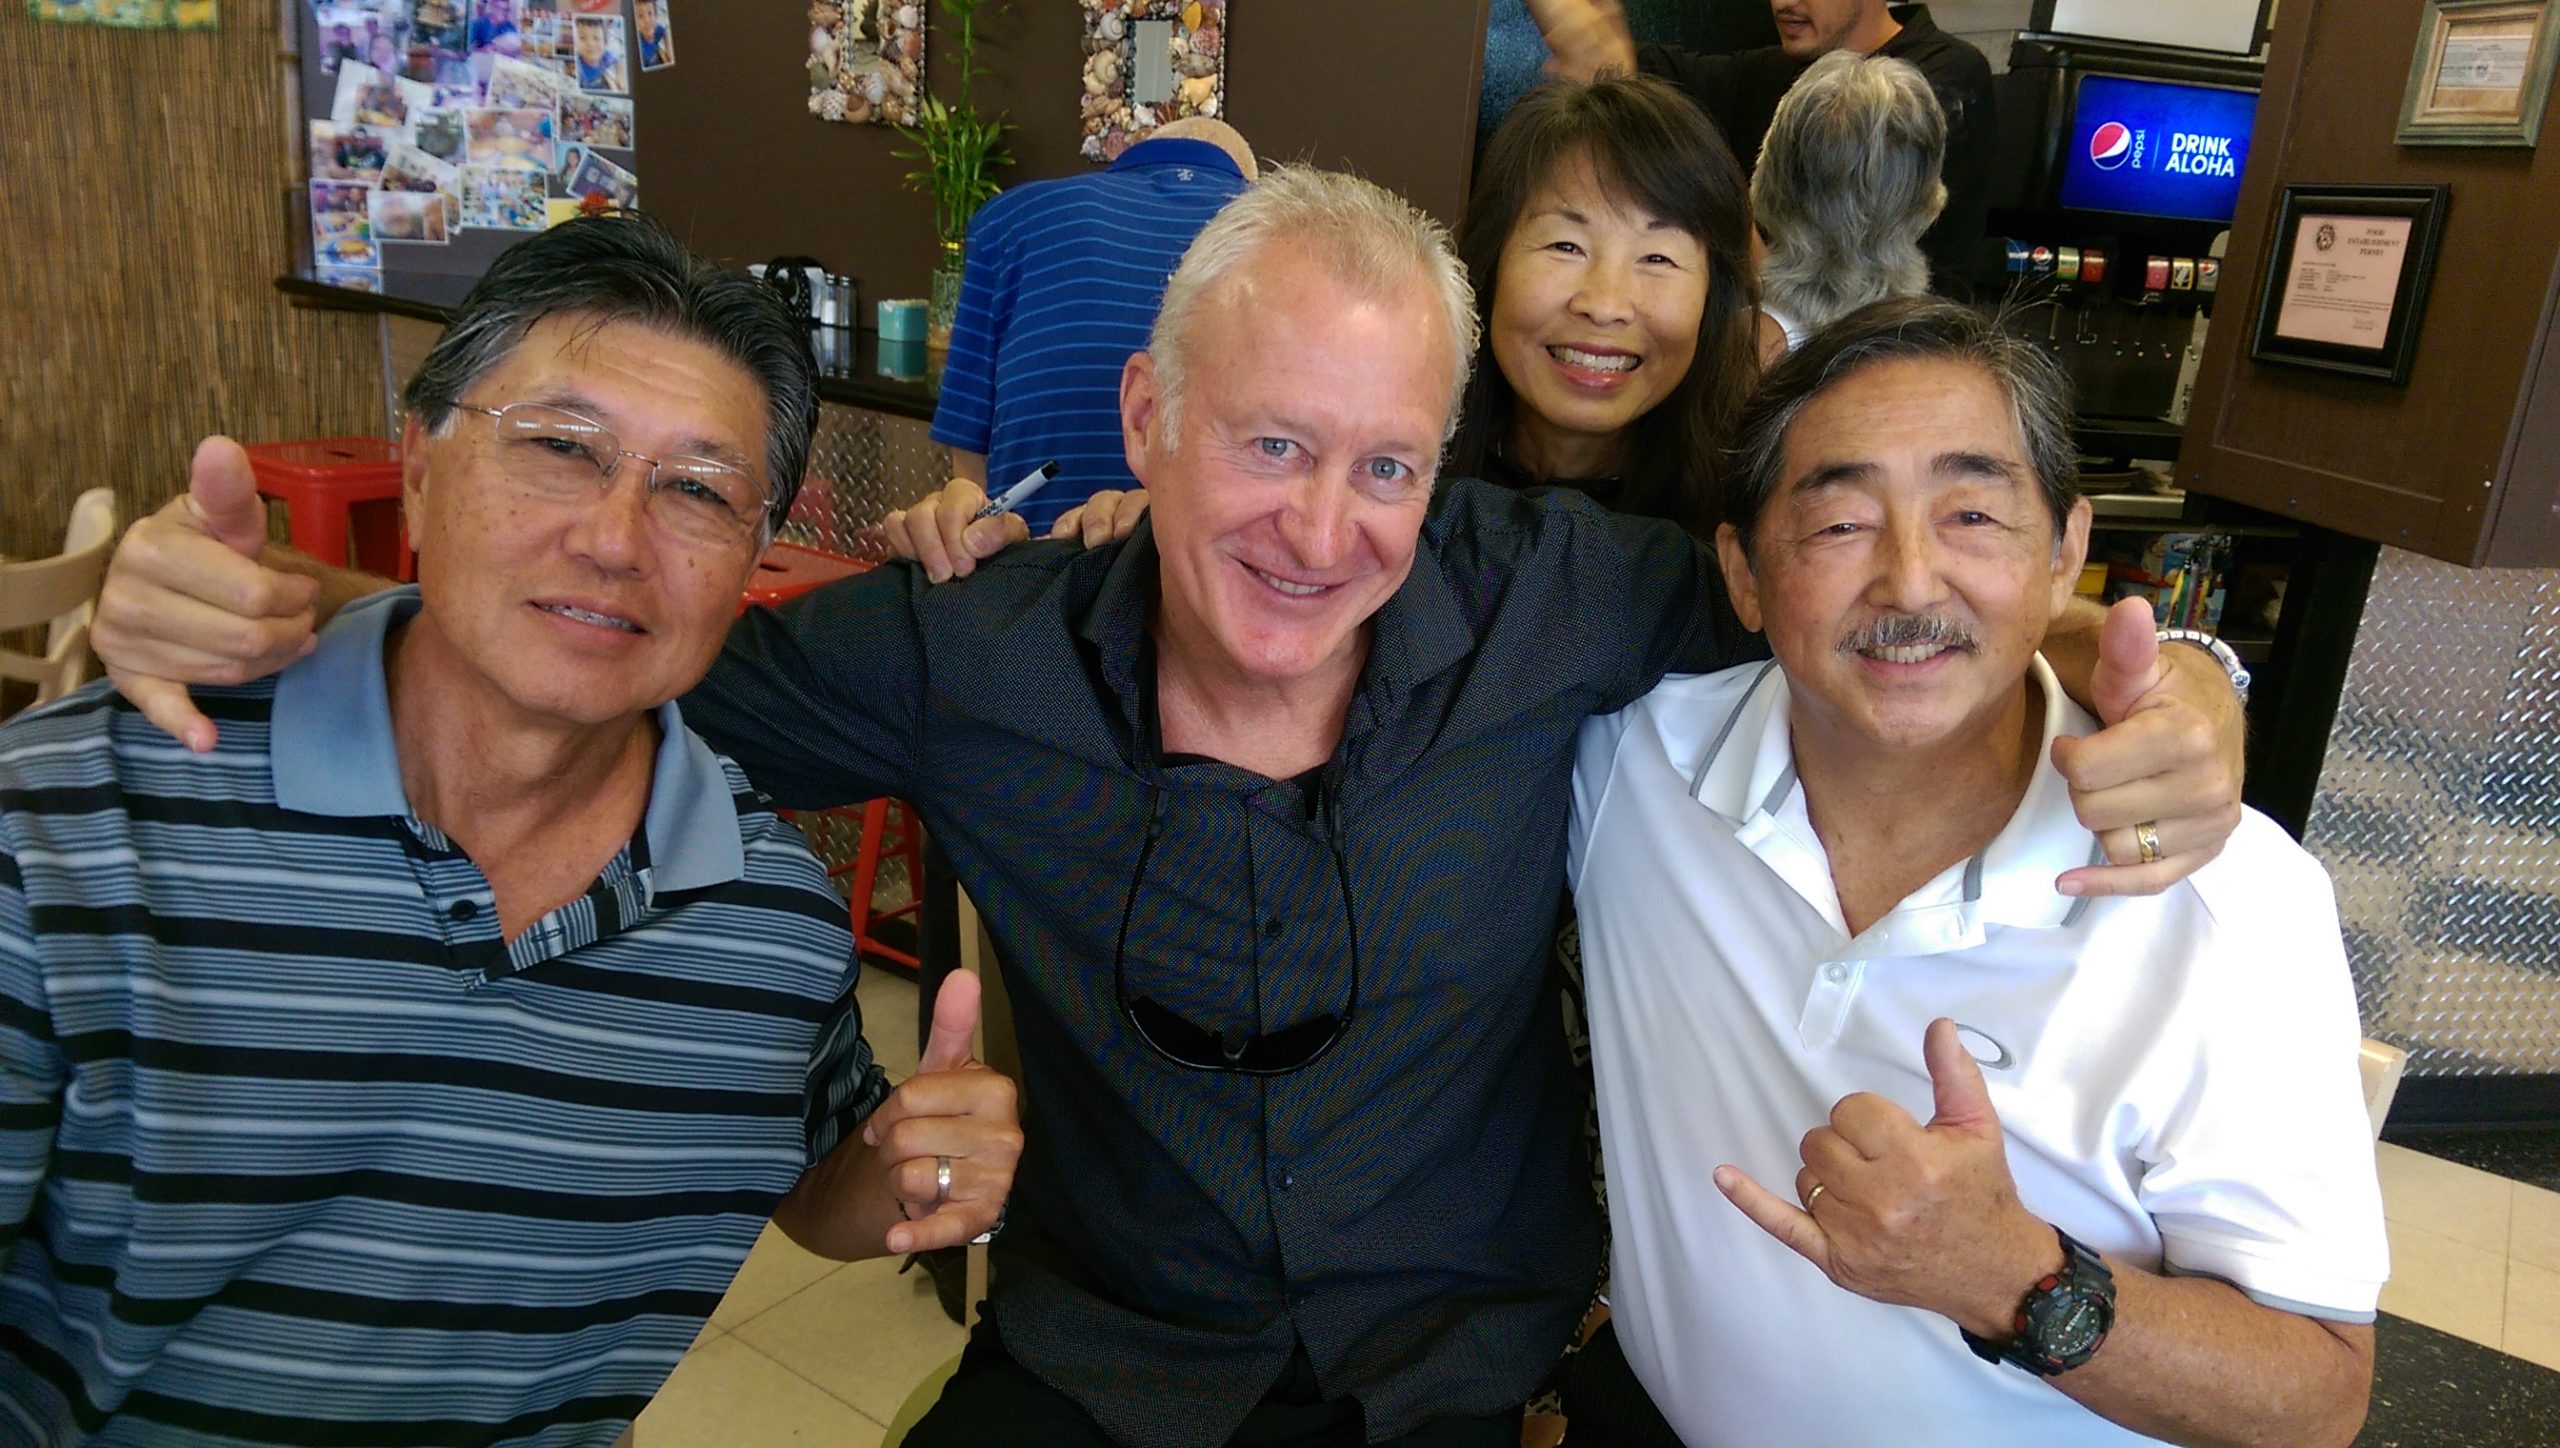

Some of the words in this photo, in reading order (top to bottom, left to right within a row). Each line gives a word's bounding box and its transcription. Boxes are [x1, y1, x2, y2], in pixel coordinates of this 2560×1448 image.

[2131, 129, 2145, 169] pepsi
[2171, 132, 2232, 157] DRINK
[2165, 152, 2235, 178] ALOHA
